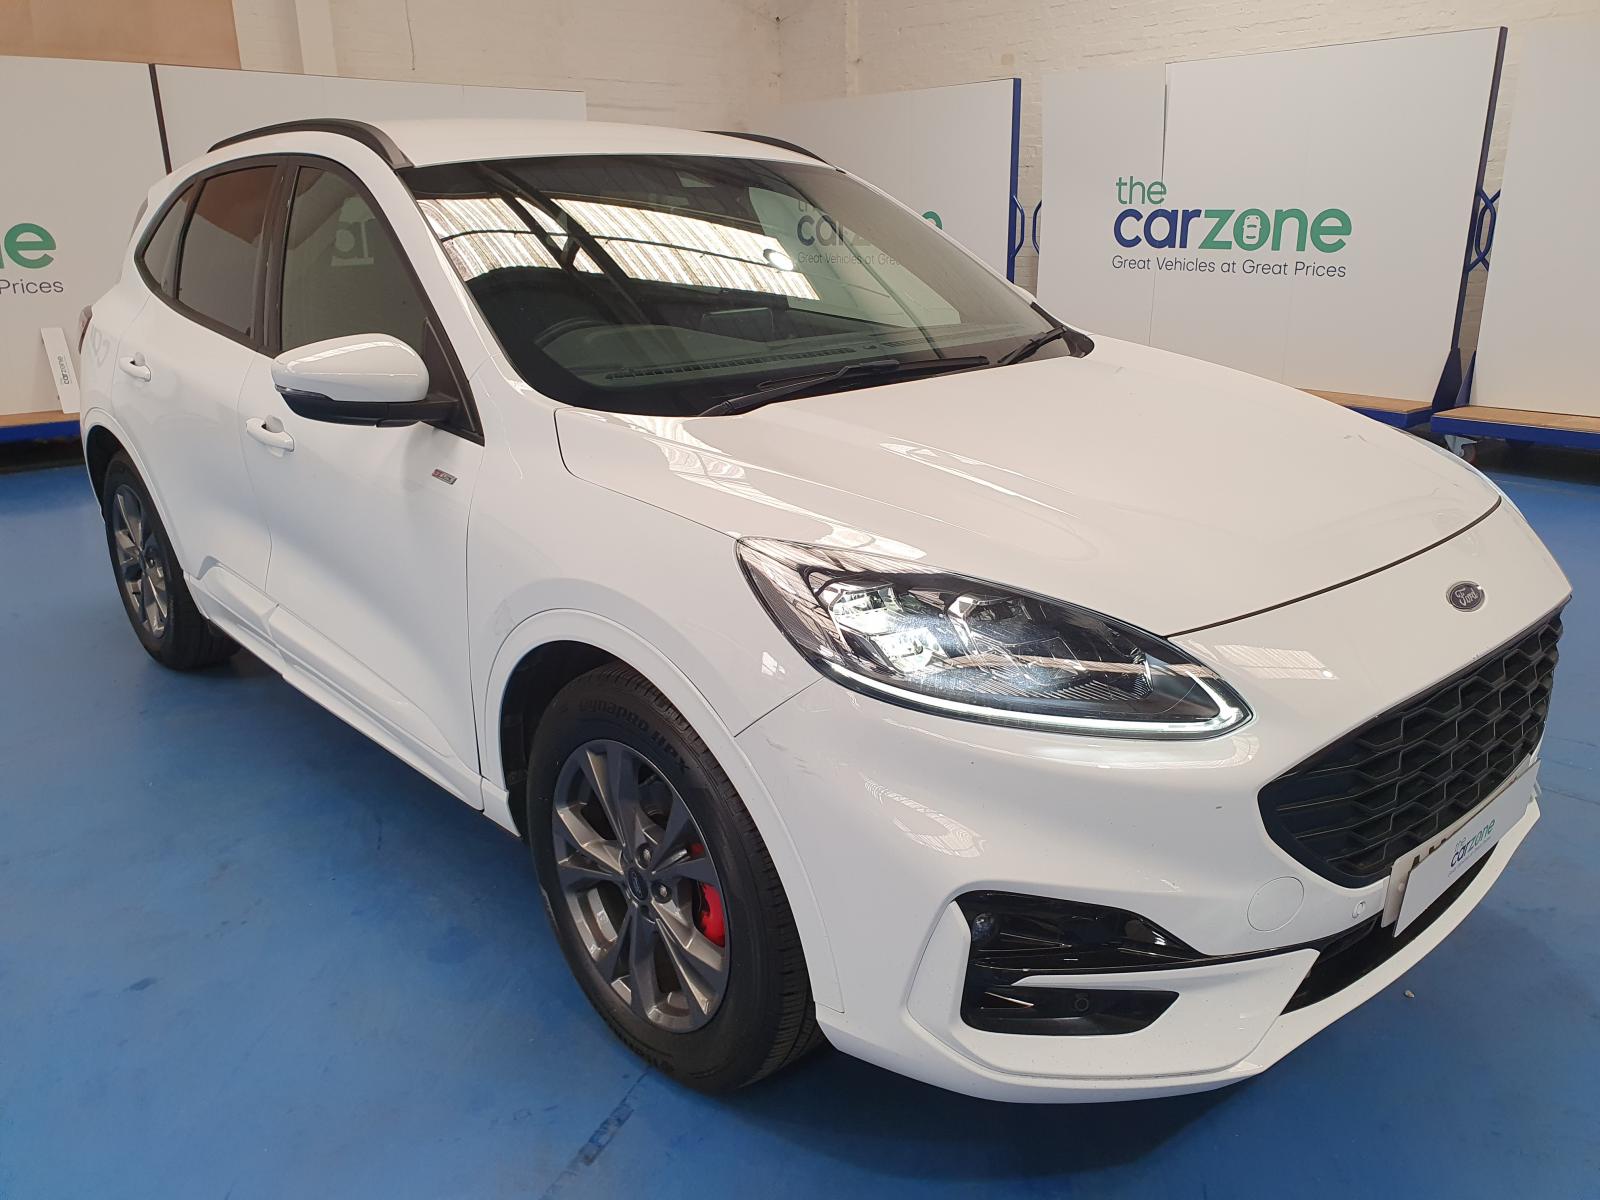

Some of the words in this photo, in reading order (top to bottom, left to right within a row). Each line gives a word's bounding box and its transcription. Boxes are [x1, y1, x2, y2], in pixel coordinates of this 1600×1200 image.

[1115, 176, 1167, 205] the
[1113, 208, 1352, 254] carzone
[1112, 255, 1150, 270] Great
[1157, 257, 1215, 273] Vehicles
[1220, 260, 1236, 274] at
[1242, 259, 1288, 276] Great
[1294, 261, 1346, 278] Prices
[0, 279, 63, 295] Prices
